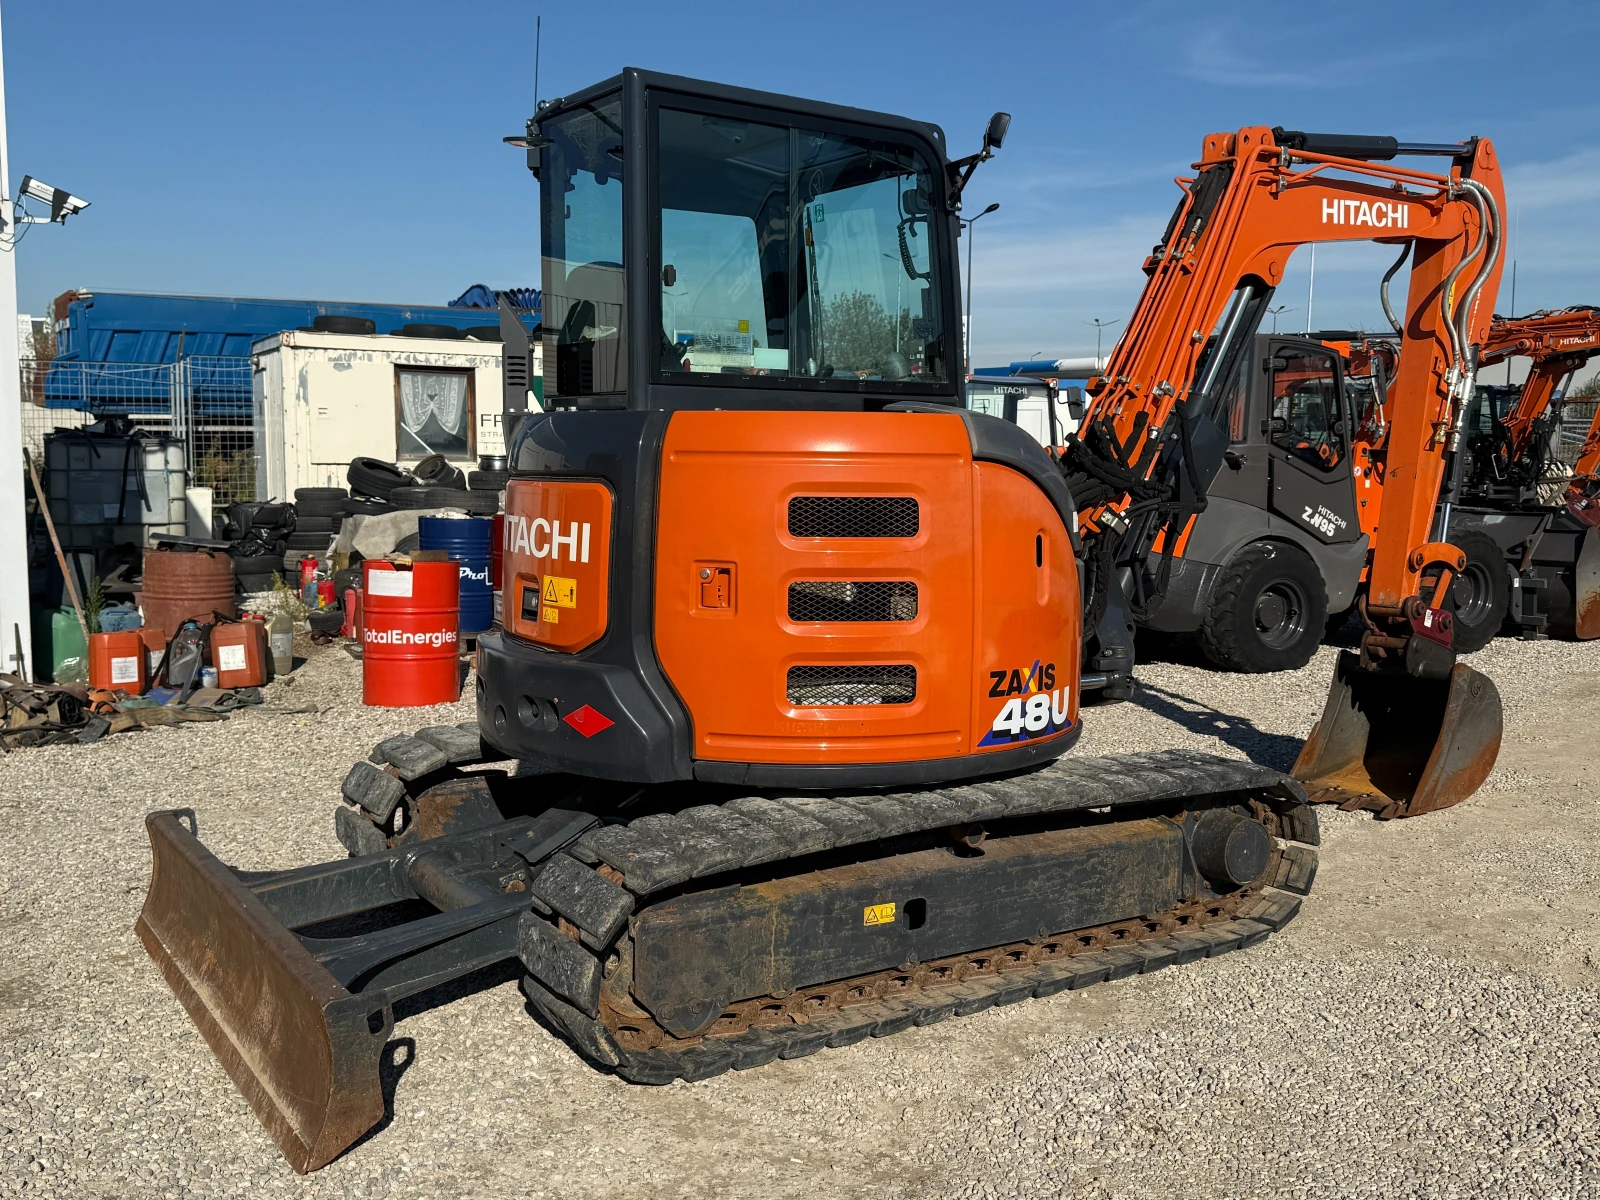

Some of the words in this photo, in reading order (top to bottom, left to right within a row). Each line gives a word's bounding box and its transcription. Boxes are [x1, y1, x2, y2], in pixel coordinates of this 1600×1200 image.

[1322, 198, 1408, 228] HITACHI
[1560, 335, 1595, 346] HITACHI
[994, 386, 1027, 395] HITACHI
[1317, 504, 1347, 529] HITACHI
[503, 514, 591, 563] ITACHI
[363, 628, 457, 648] TotalEnergies
[988, 659, 1056, 698] ZAXIS
[992, 685, 1070, 735] 48U
